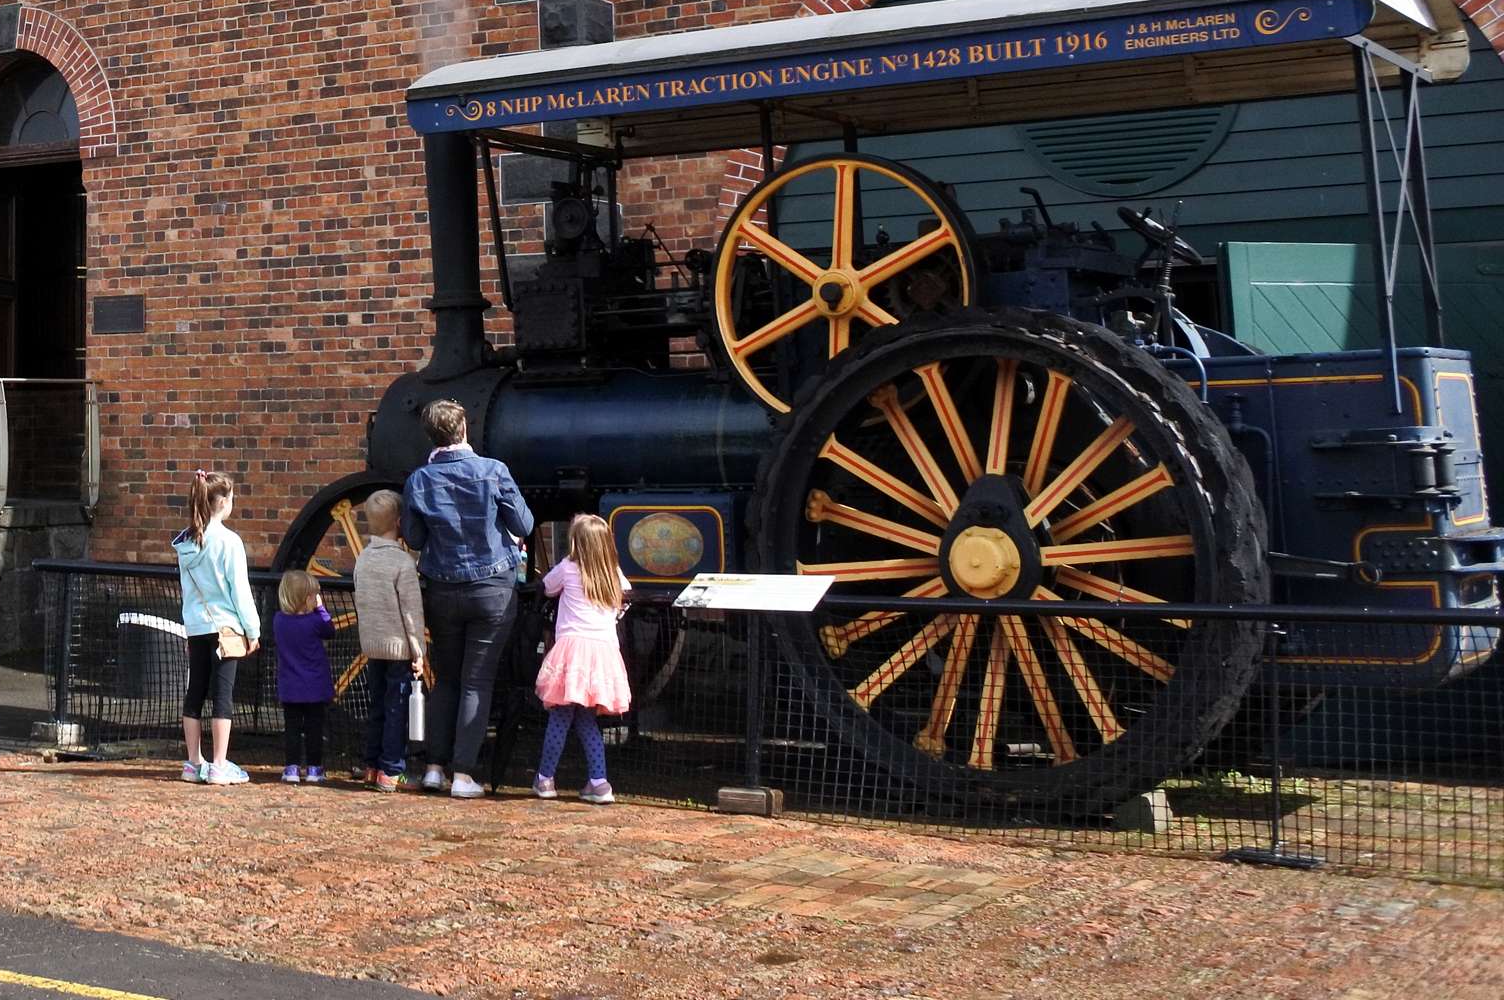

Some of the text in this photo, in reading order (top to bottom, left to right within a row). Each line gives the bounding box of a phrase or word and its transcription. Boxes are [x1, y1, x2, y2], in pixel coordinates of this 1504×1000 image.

[1127, 12, 1236, 35] J & H McLAREN
[1124, 27, 1241, 50] ENGINEERS LTD
[486, 101, 496, 117] 8
[500, 96, 542, 116] NHP
[547, 83, 651, 111] McLAREN
[655, 69, 773, 98] TRACTION
[780, 58, 873, 84] ENGINE
[912, 48, 962, 70] 1428
[967, 38, 1046, 64] BUILT
[1055, 31, 1108, 54] 1916
